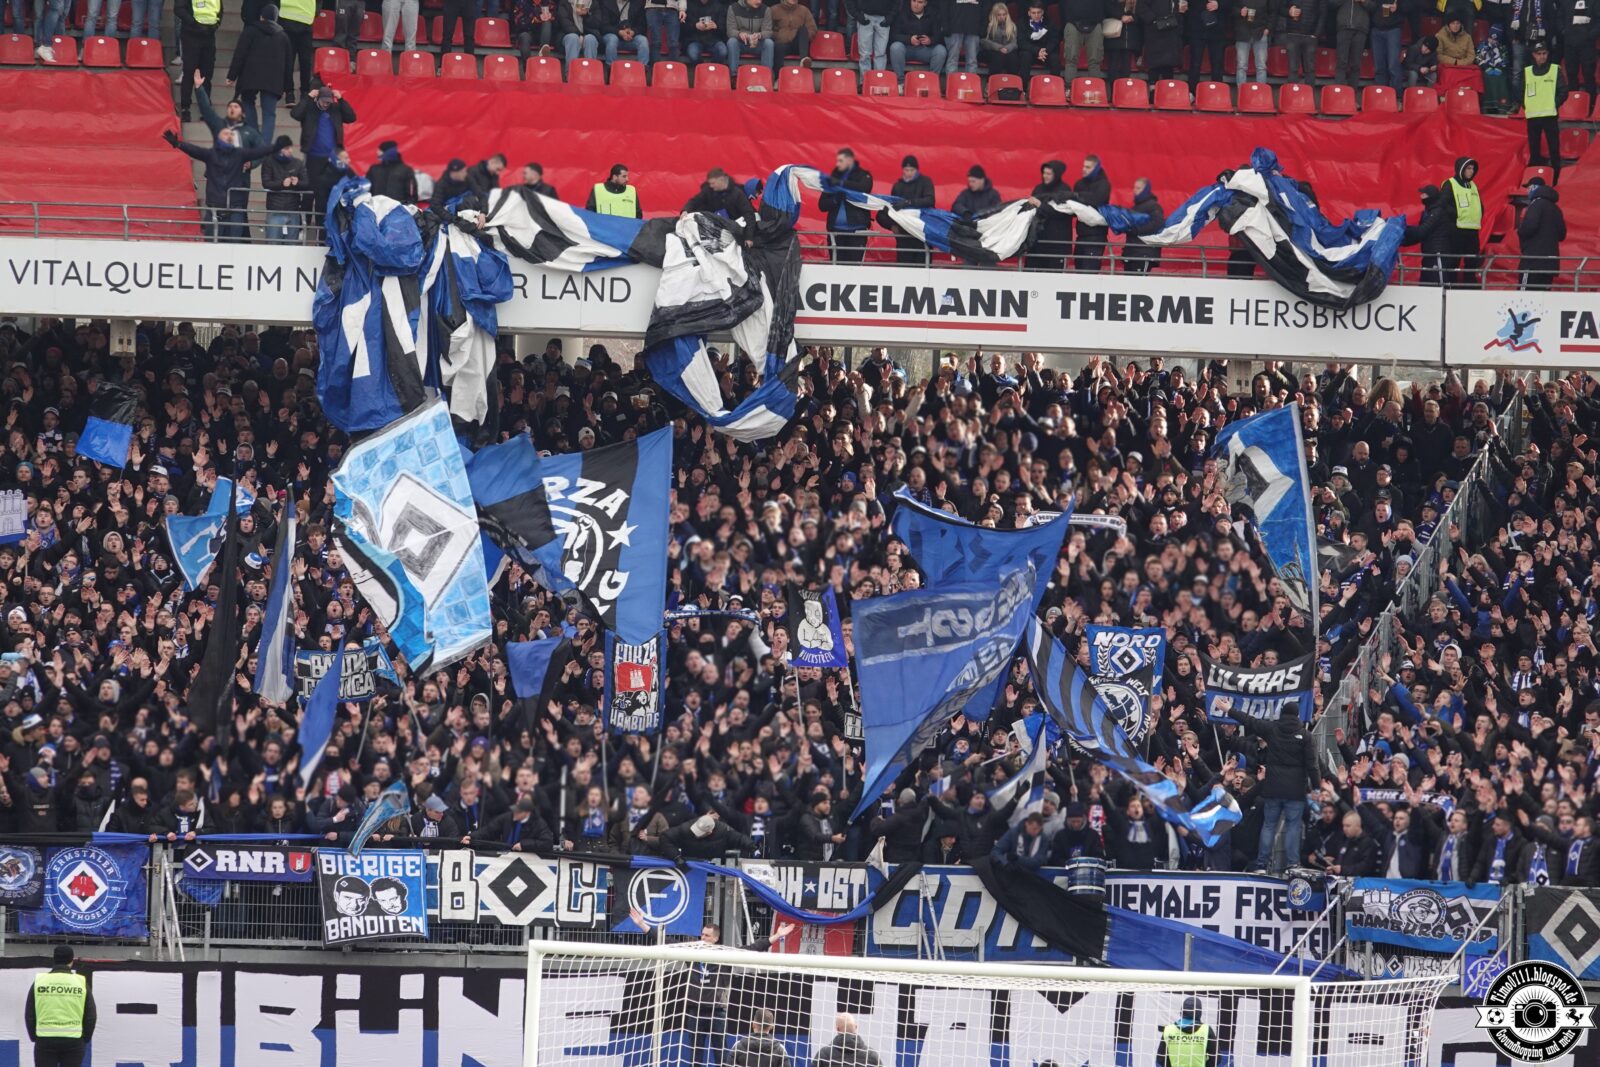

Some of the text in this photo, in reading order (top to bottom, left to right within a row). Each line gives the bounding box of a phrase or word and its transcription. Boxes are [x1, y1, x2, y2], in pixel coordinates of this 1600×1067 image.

[9, 258, 235, 293] VITALQUELLE
[247, 265, 282, 292] IM
[541, 275, 632, 303] LAND
[1056, 291, 1214, 325] THERME
[1229, 298, 1418, 332] HERSBRUCK
[542, 476, 630, 519] RZA
[1093, 631, 1162, 648] NORD
[1126, 677, 1150, 697] WELT
[1206, 663, 1304, 694] ULTRAS
[1137, 713, 1151, 742] BLAU
[53, 850, 115, 875] ERMSTALER
[215, 850, 286, 874] RNR
[319, 854, 422, 877] BIERIGE
[817, 868, 867, 909] OST
[59, 904, 108, 921] ROTHOSEN
[325, 915, 425, 940] BANDITEN
[1351, 913, 1446, 940] HAMBURG
[50, 986, 83, 995] POWER
